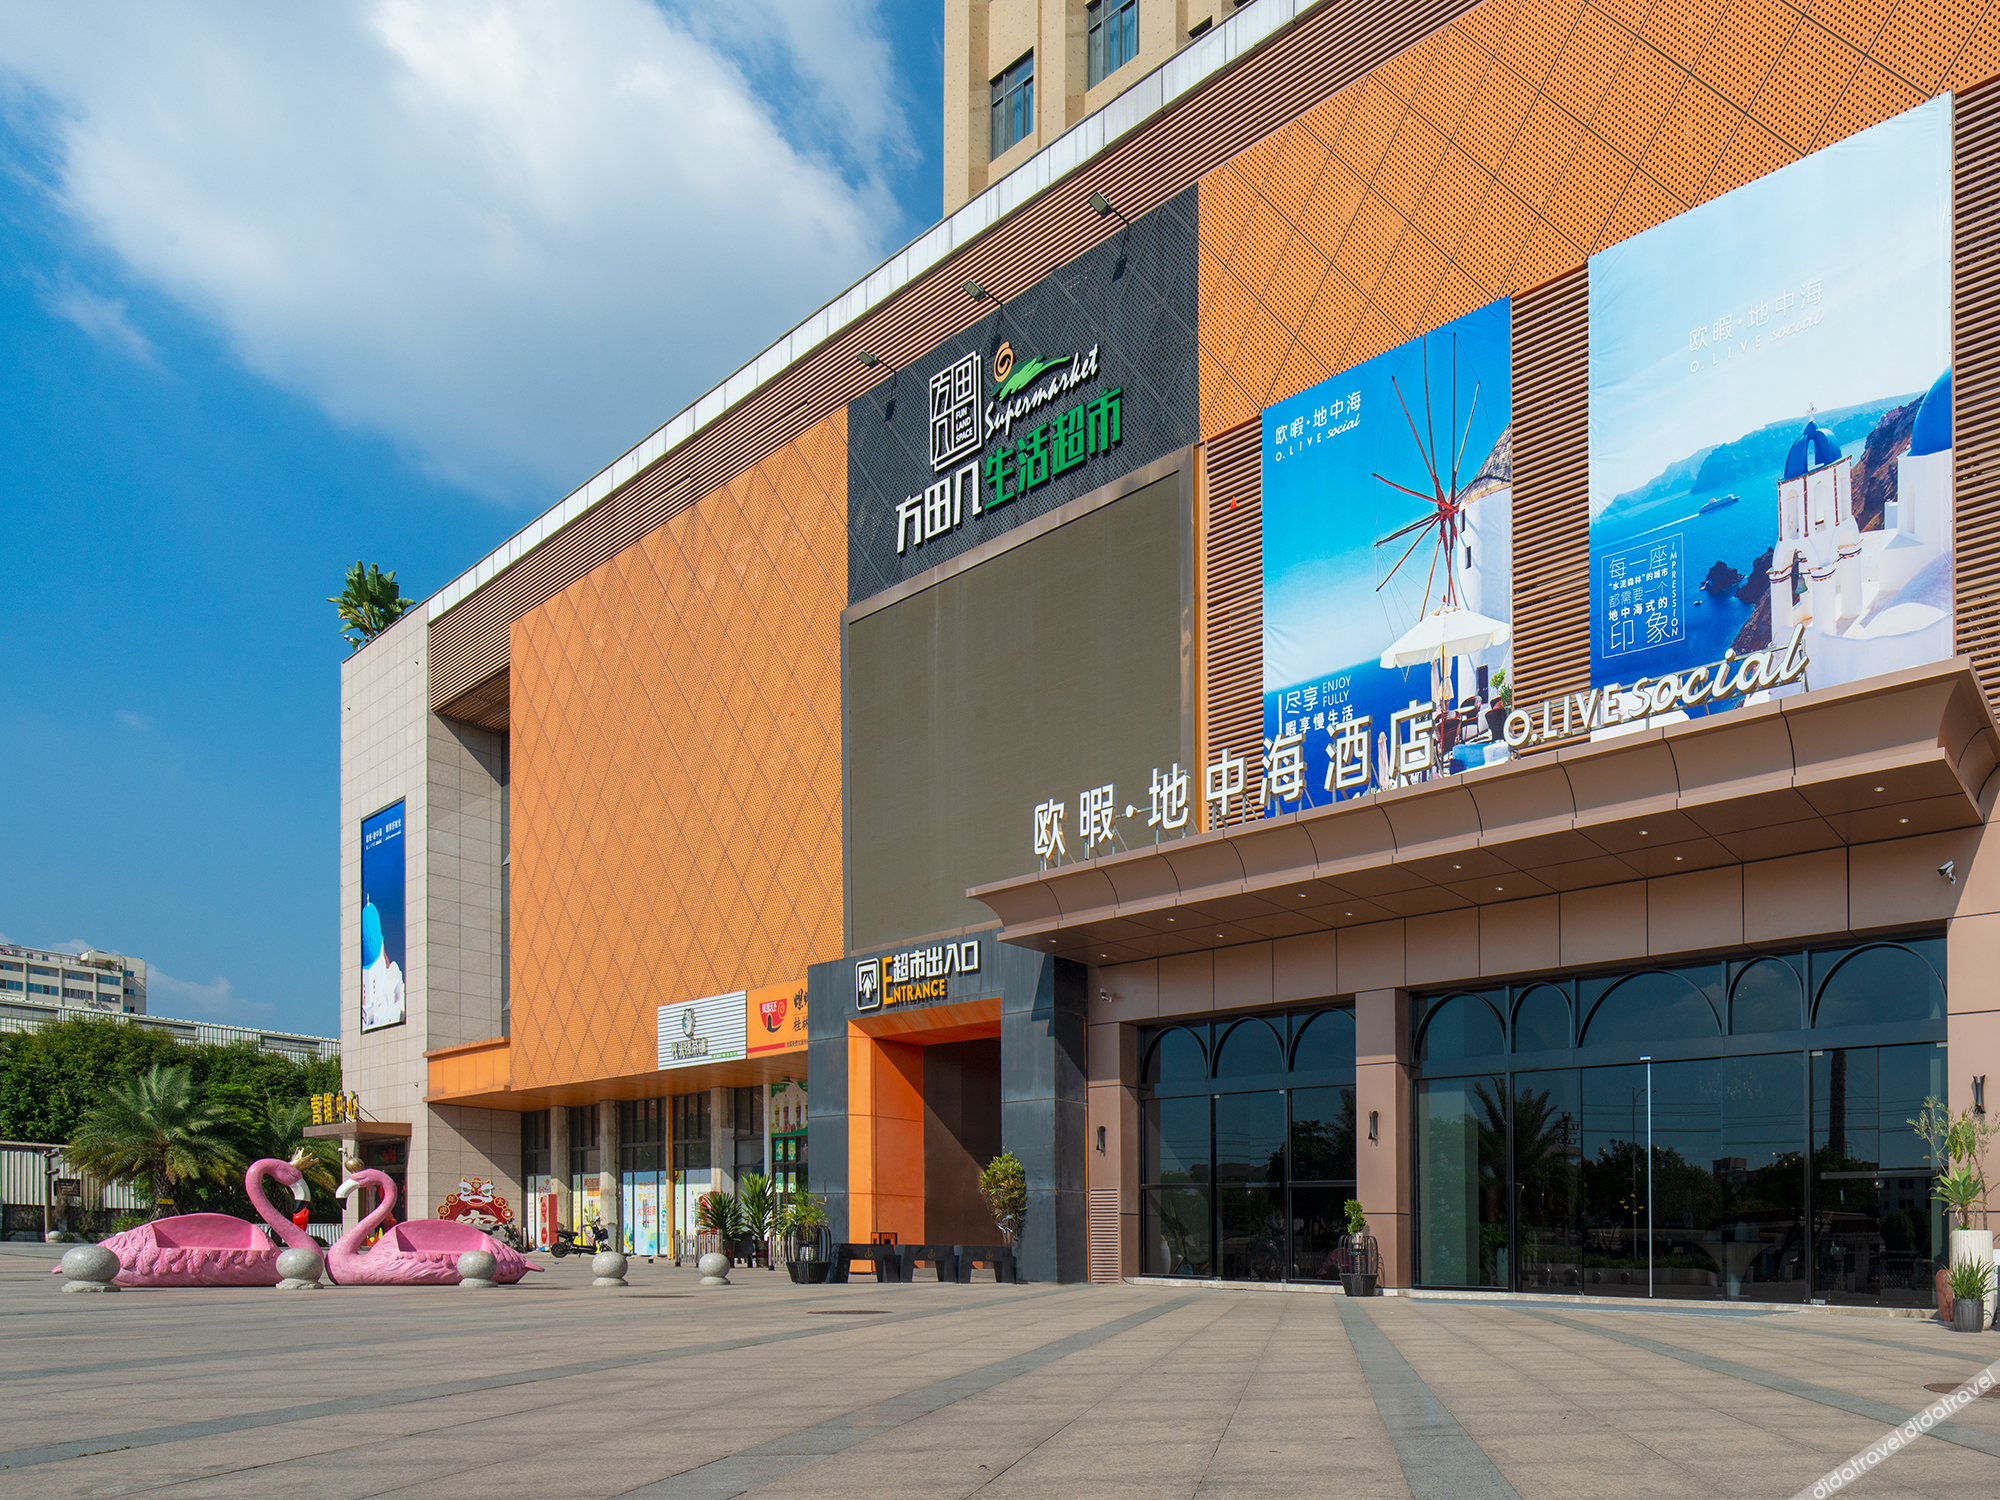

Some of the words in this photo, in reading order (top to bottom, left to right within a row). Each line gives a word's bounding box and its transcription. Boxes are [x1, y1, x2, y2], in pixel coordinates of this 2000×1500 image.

[1689, 278, 1823, 352] 欧暇·地中海
[1770, 308, 1824, 342] social
[985, 344, 1099, 440] Supermarket
[956, 406, 968, 420] FUN
[956, 417, 972, 432] LAND
[1275, 390, 1362, 445] 欧暇·地中海
[1326, 413, 1361, 439] social
[956, 427, 973, 444] SPACE
[1609, 545, 1668, 579] 每一座
[1609, 581, 1668, 608] 都需要一个
[1670, 542, 1679, 636] IMPRESSION
[1608, 596, 1668, 621] 地中海式的
[1611, 612, 1670, 651] 印象
[1285, 686, 1319, 714] 尽享
[1322, 675, 1352, 694] ENJOY
[1322, 690, 1349, 707] FULLY
[1285, 704, 1354, 736] 暇享慢生活
[1503, 683, 1624, 749] O.LIVE
[893, 940, 979, 983] 超市出入口
[882, 956, 946, 1005] ENTRANCE
[310, 1090, 357, 1125] 营销中心
